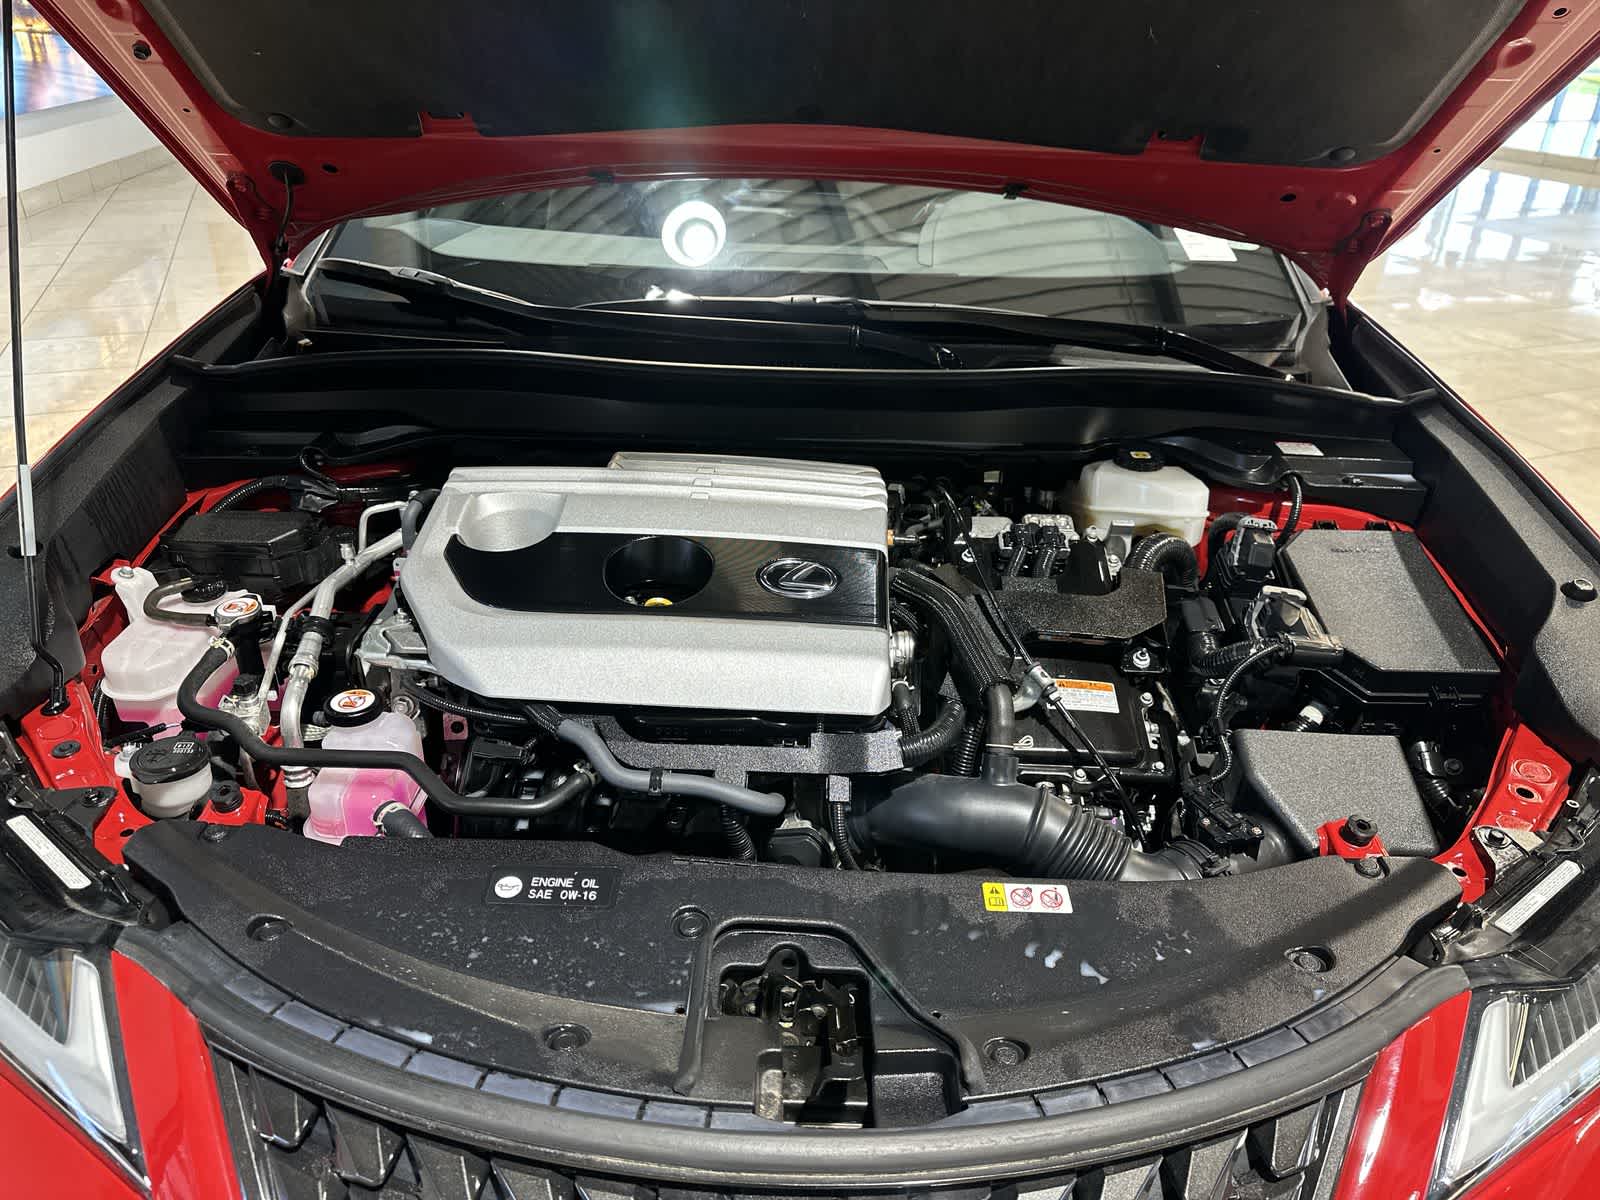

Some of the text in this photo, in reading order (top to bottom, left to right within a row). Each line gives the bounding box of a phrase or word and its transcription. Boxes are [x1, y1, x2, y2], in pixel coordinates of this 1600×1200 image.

[531, 877, 600, 889] ENGINE OIL
[528, 889, 597, 900] SAE 0W-16
